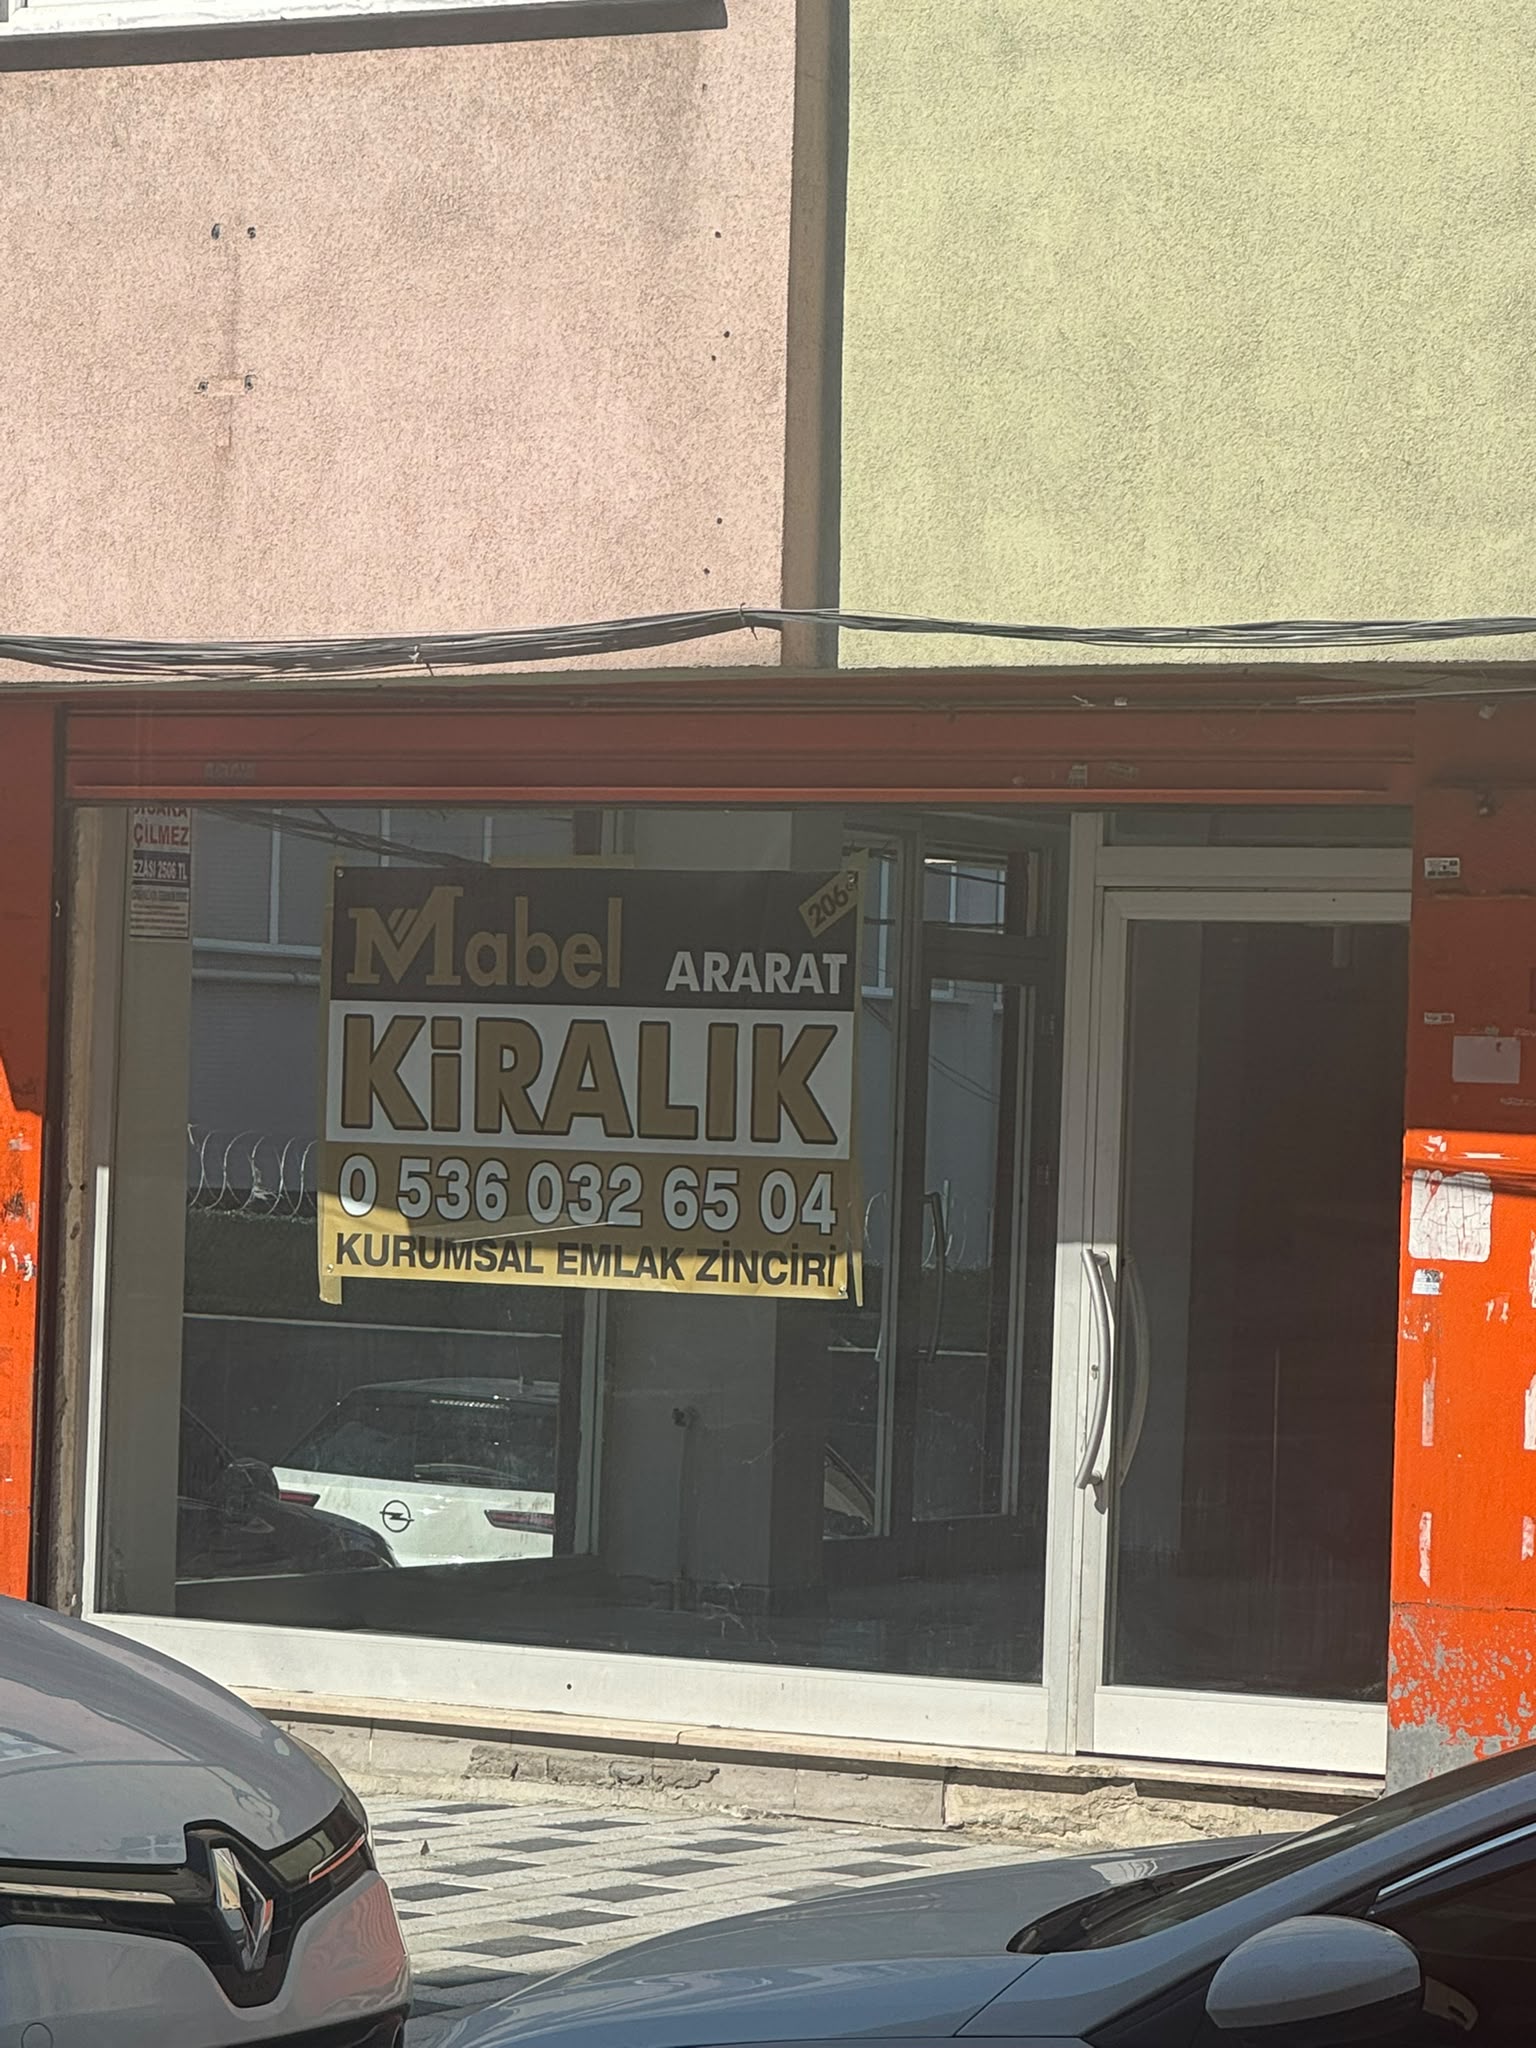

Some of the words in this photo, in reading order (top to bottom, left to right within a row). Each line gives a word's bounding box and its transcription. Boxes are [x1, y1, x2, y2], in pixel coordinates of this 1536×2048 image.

[346, 885, 623, 989] Mabel
[664, 951, 848, 995] ARARAT
[339, 1153, 378, 1218] 0
[396, 1156, 510, 1223] 536
[526, 1160, 643, 1228] 032
[661, 1165, 740, 1233] 65
[759, 1168, 838, 1236] 04
[336, 1232, 544, 1275] KURUMSAL
[557, 1242, 685, 1282] EMLAK
[695, 1240, 838, 1288] ZİNCİRİ
